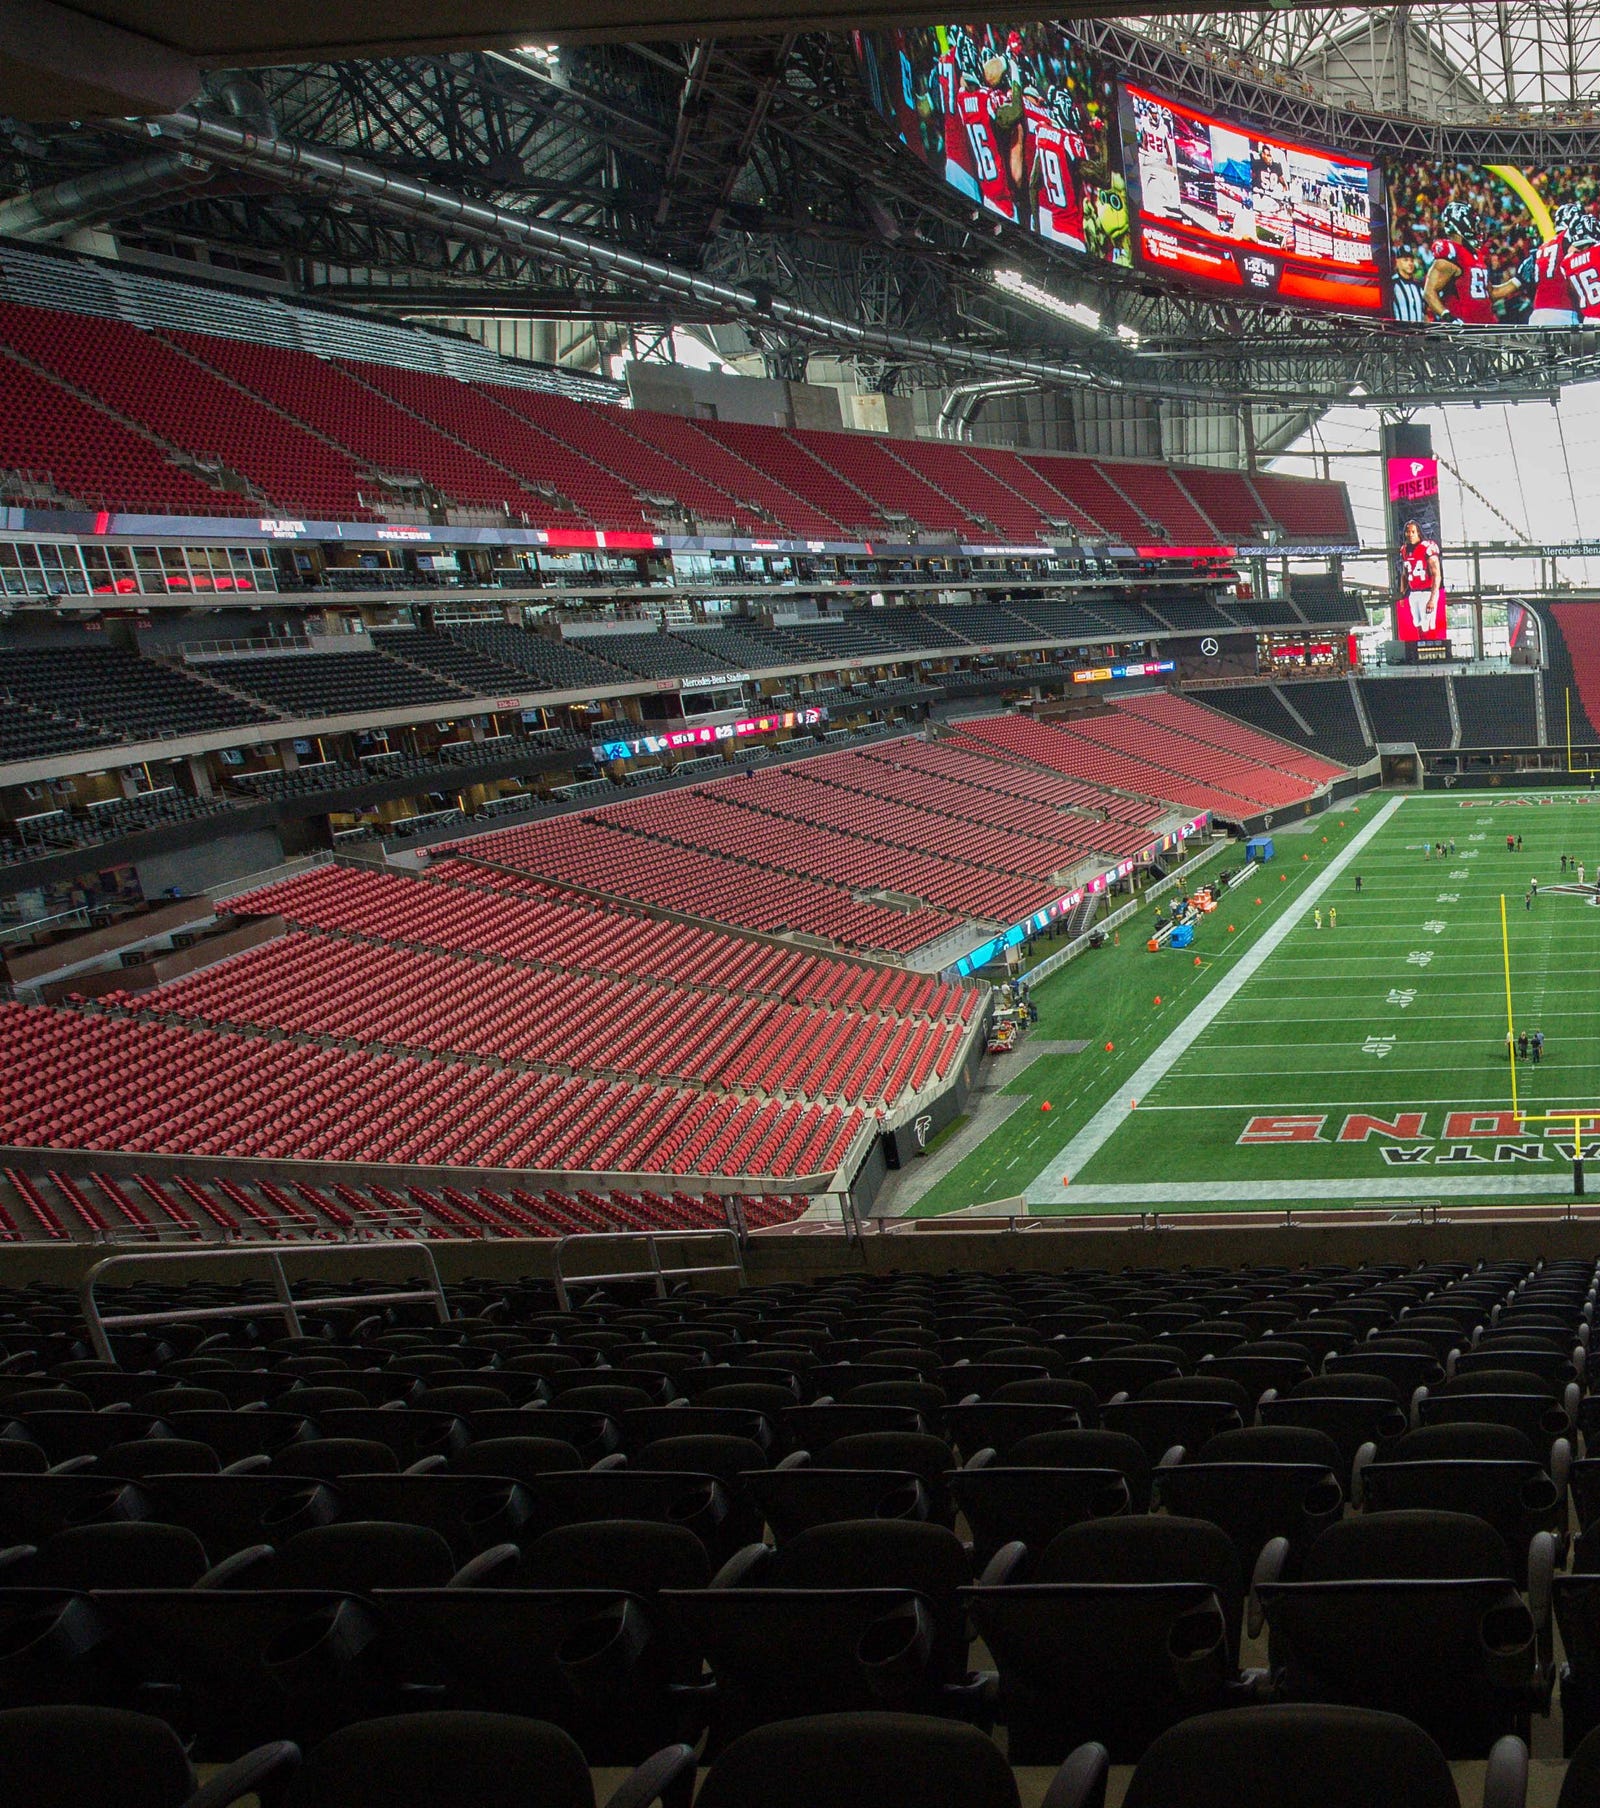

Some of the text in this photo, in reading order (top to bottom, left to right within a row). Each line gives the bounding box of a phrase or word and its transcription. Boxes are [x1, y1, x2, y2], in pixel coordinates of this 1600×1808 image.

[966, 123, 997, 181] 16
[1038, 148, 1067, 208] 19
[1261, 261, 1275, 276] PM
[1397, 477, 1438, 497] RISE UP
[682, 671, 750, 689] Mercedes-Benz Stadium
[632, 740, 640, 754] 7
[715, 725, 733, 739] 0:25
[1386, 989, 1418, 1003] 20
[1361, 1034, 1397, 1052] 10
